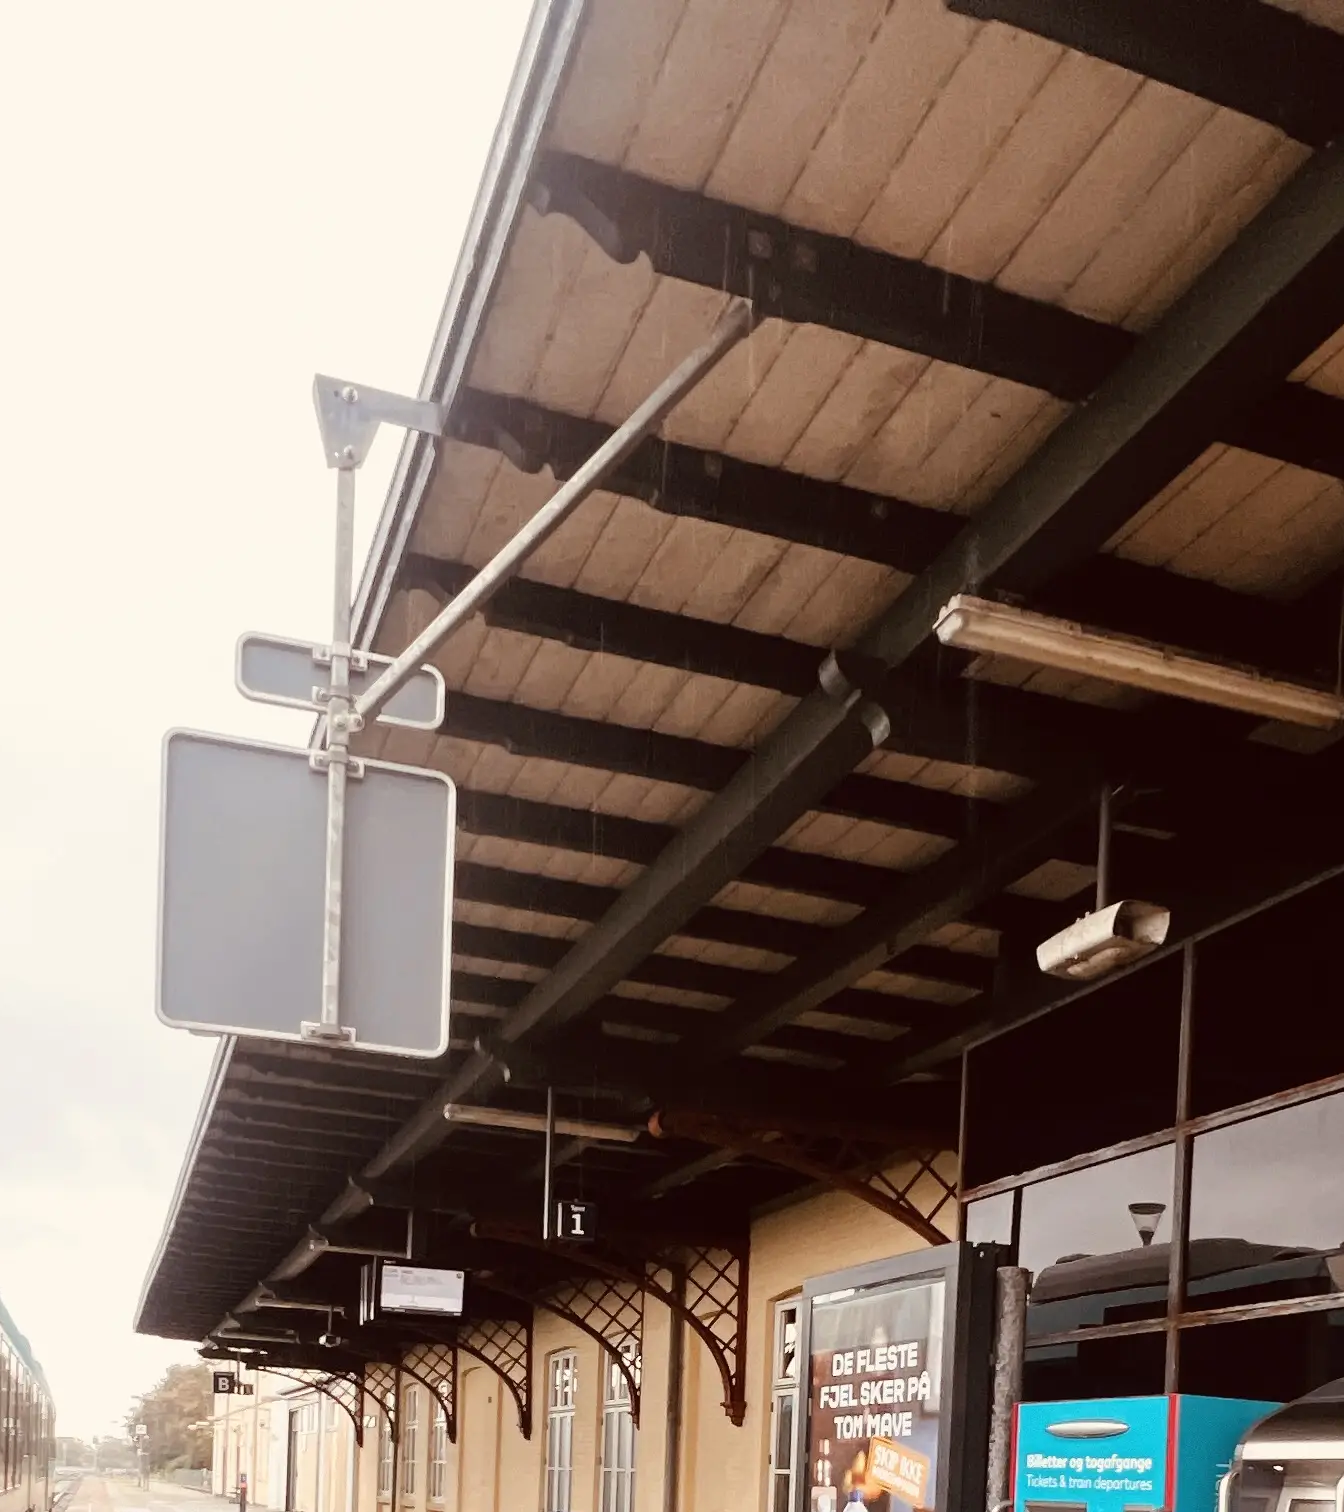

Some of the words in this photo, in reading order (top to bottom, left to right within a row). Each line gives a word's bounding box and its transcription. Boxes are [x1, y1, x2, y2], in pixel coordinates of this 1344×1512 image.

[571, 1213, 585, 1235] 1
[832, 1351, 854, 1377] DE
[856, 1341, 919, 1375] FLESTE
[218, 1377, 229, 1391] B
[860, 1378, 905, 1406] SKER
[907, 1371, 931, 1401] PÅ
[834, 1414, 863, 1440] TOM
[866, 1411, 912, 1438] MAVE
[1026, 1453, 1068, 1469] Billetter
[1069, 1458, 1084, 1473] og
[1085, 1453, 1153, 1473] togafgange
[1026, 1473, 1058, 1488] Tickets
[1059, 1474, 1066, 1488] &
[1068, 1476, 1092, 1489] train
[1094, 1475, 1153, 1491] departures
